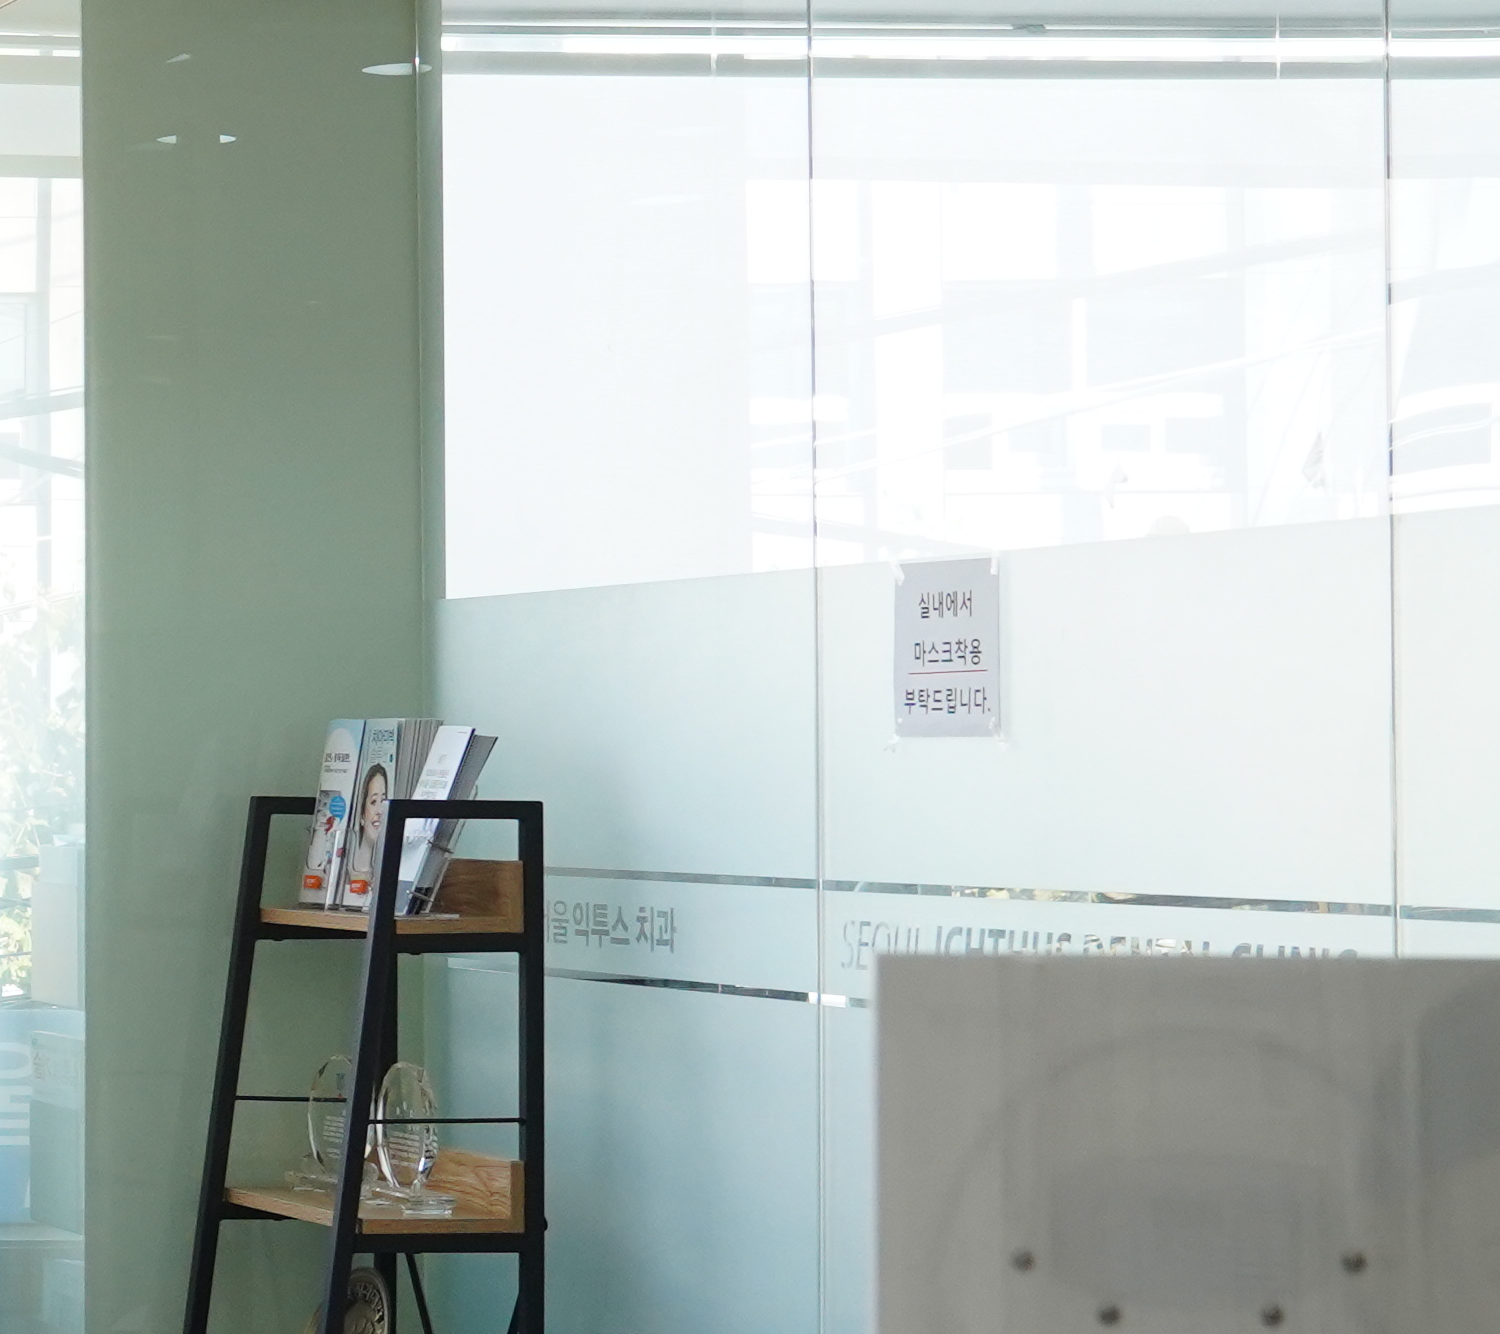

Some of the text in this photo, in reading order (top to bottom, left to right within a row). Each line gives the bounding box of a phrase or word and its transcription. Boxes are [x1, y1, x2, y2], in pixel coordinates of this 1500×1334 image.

[918, 589, 975, 620] 실내에서
[913, 637, 983, 667] 마스크착용
[903, 685, 992, 717] 부탁드립니다.
[635, 907, 678, 955] 치과
